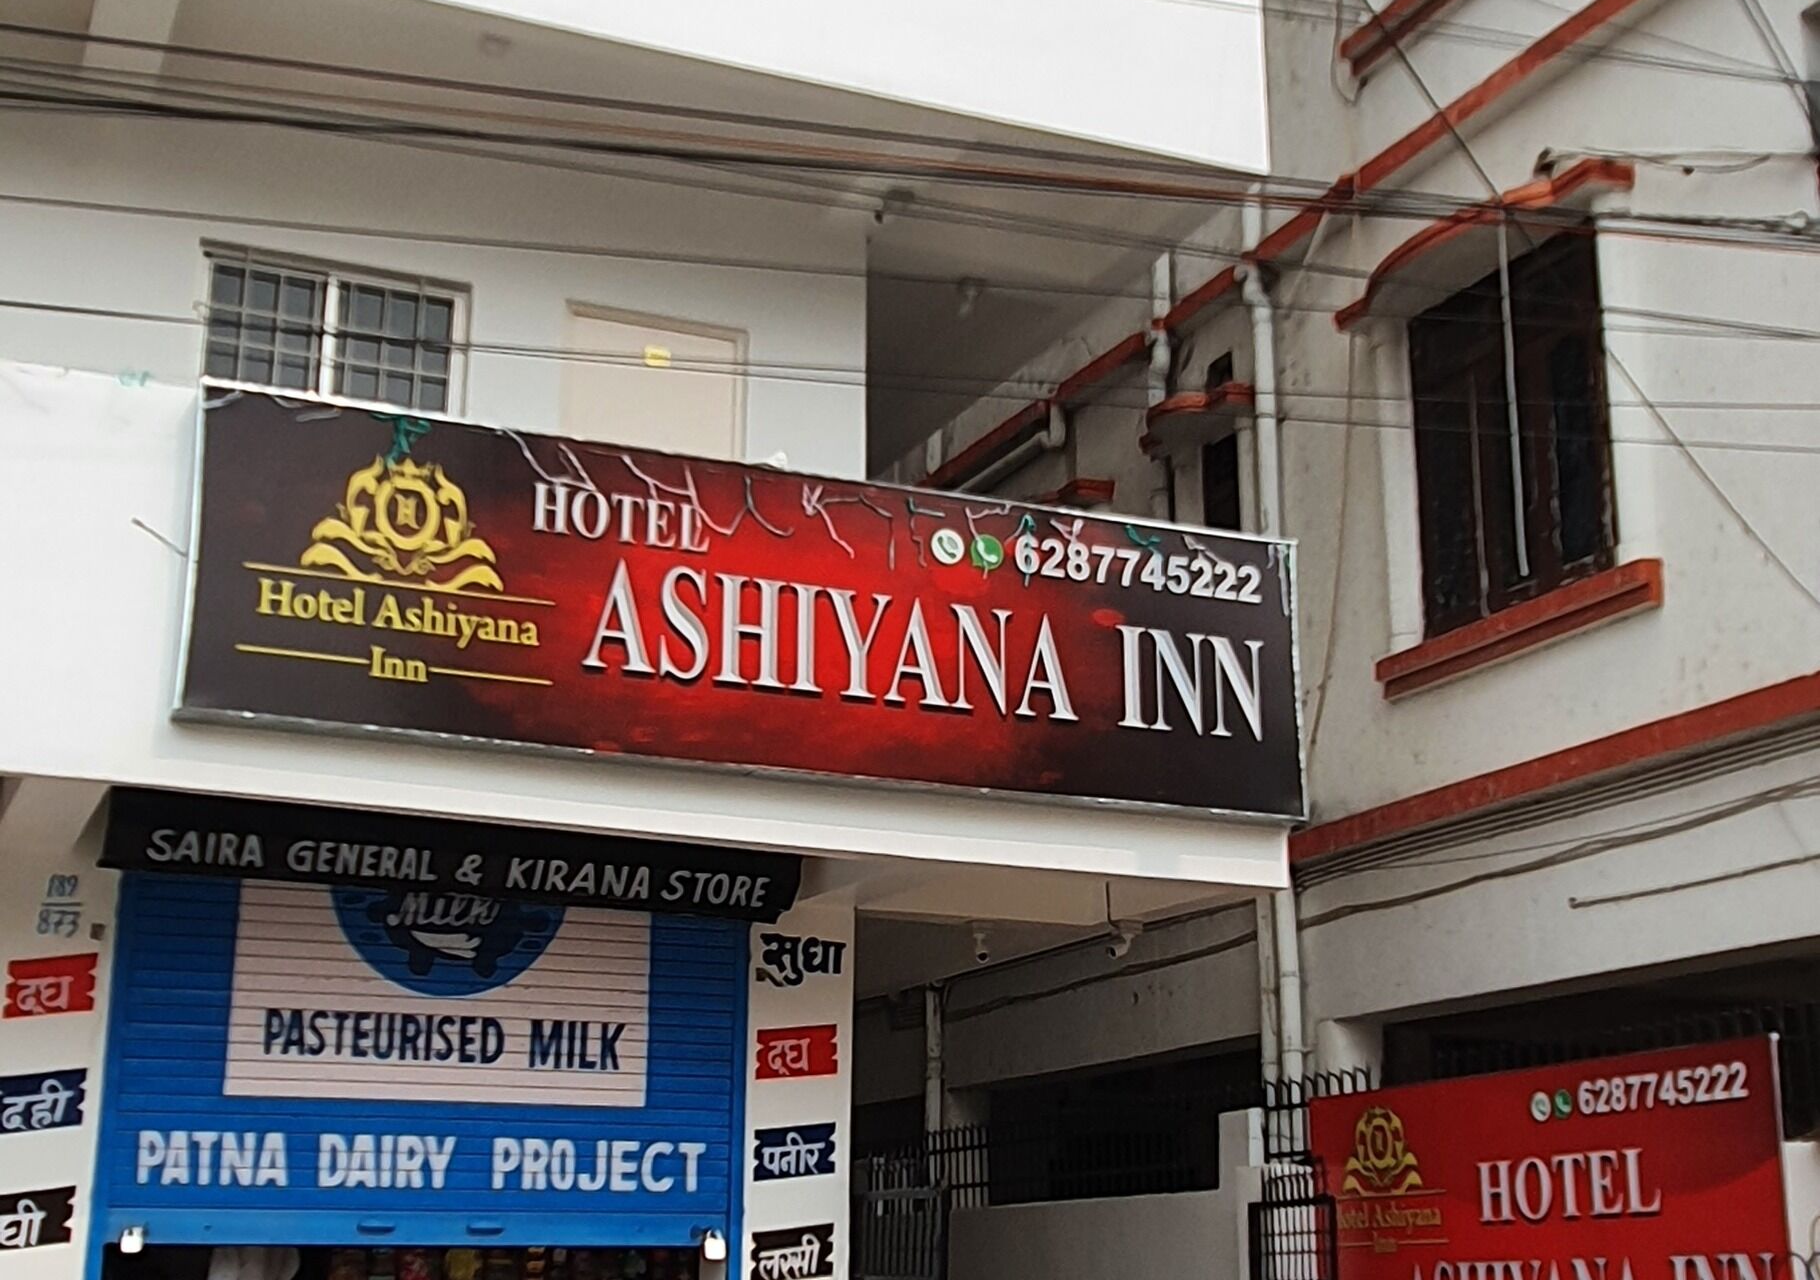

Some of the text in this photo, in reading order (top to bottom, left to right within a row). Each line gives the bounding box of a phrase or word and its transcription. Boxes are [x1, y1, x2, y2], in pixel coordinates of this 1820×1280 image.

[532, 482, 711, 553] HOTEL
[1014, 537, 1263, 604] 6287745222
[256, 577, 541, 649] Hotel Ashiyana
[368, 645, 430, 683] Inn
[580, 558, 1266, 743] ASHIYANA INN
[145, 829, 772, 908] SAIRA GENERAL & KIRANA STORE
[759, 932, 848, 987] सुधा
[263, 1007, 625, 1071] PASTEURISED MILK
[1, 1078, 75, 1130] दही
[1577, 1061, 1750, 1115] 6287745222
[136, 1130, 707, 1193] PATNA DAIRY PROJECT
[761, 1131, 826, 1176] पनीर
[1476, 1147, 1662, 1223] HOTEL
